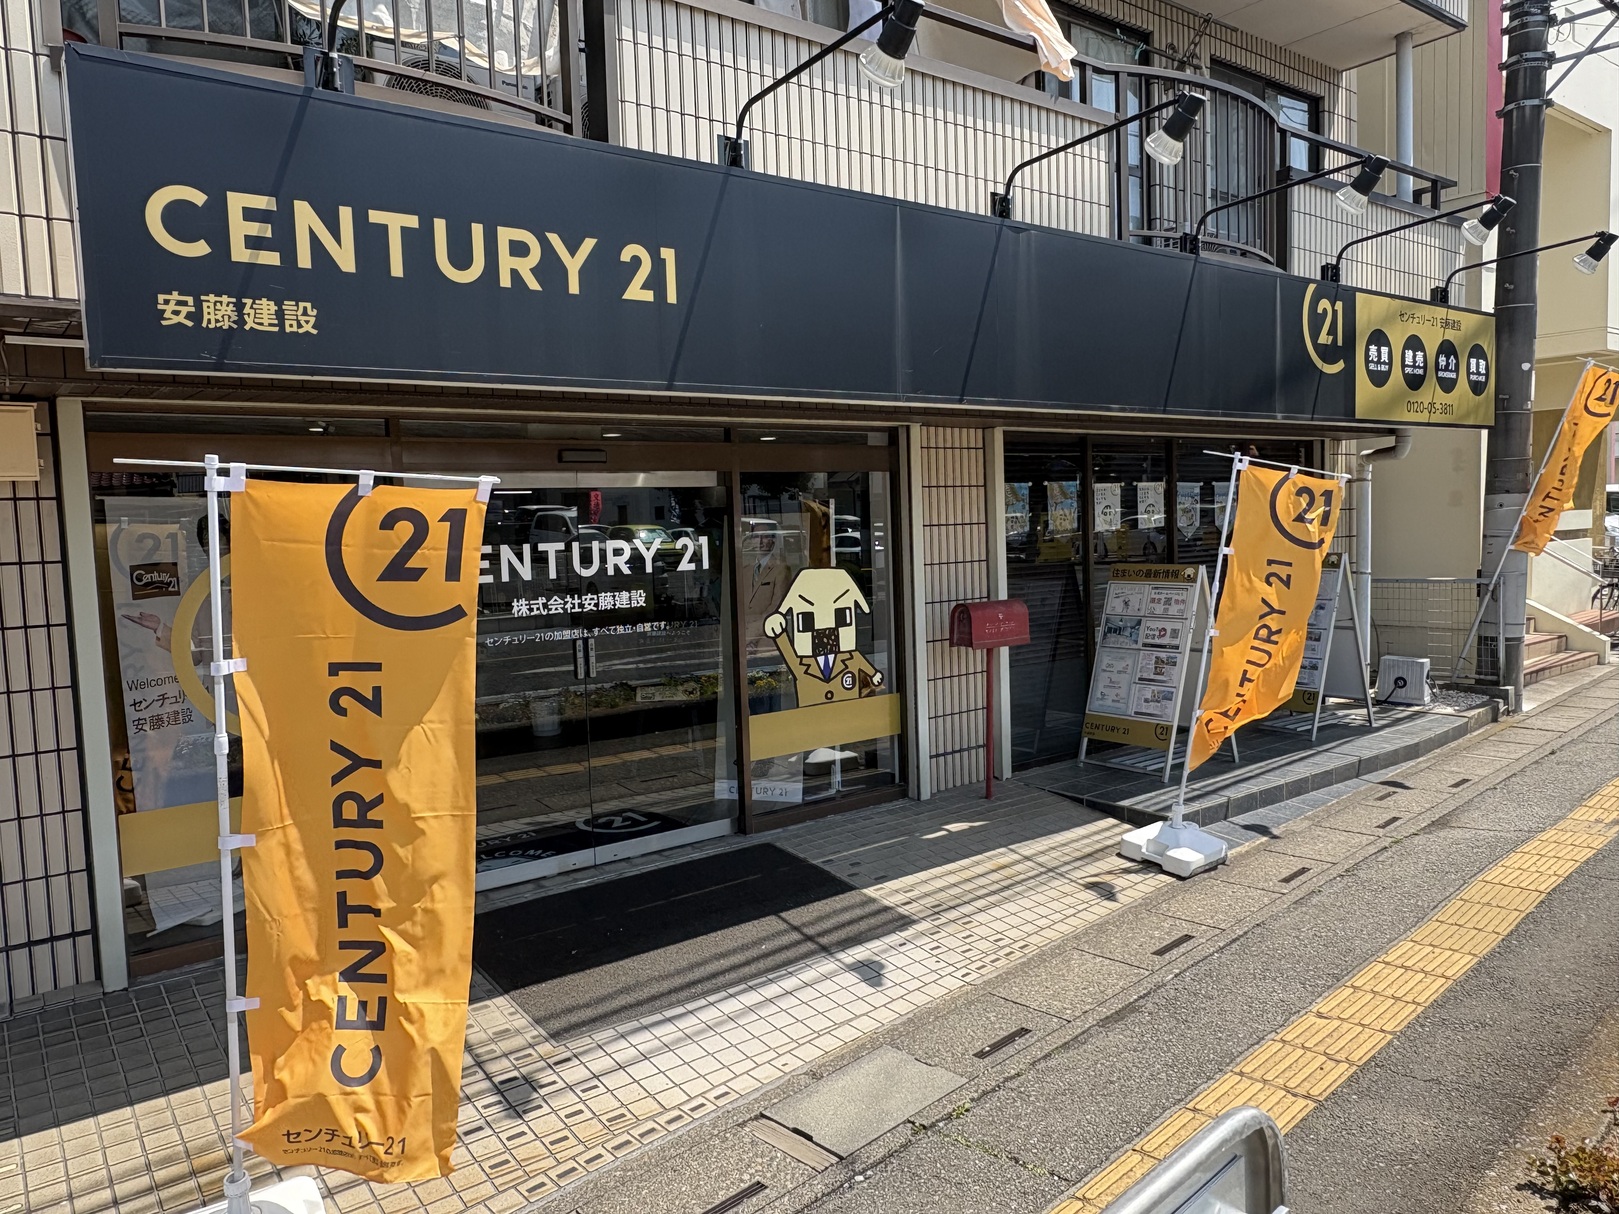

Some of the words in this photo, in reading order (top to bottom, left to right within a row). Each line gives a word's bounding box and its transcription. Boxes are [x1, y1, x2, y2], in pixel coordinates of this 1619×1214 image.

[144, 184, 598, 295] CENTURY
[620, 243, 677, 304] 21
[156, 291, 319, 335] 安藤建設
[1406, 400, 1454, 416] 0120-05-3811
[1292, 485, 1334, 527] 21
[375, 507, 468, 583] 21
[478, 538, 664, 584] ENTURY
[675, 535, 709, 571] 21
[133, 570, 170, 586] Century
[168, 577, 178, 591] 21
[1112, 567, 1180, 580] 住まいの最新情報
[1265, 558, 1293, 590] 21
[511, 589, 647, 618] 株式会社安藤建設
[327, 661, 382, 718] 21
[132, 708, 194, 735] 安藤建設
[1085, 722, 1120, 734] CENTURY
[1122, 727, 1130, 736] 21
[330, 739, 389, 1088] CENTURY
